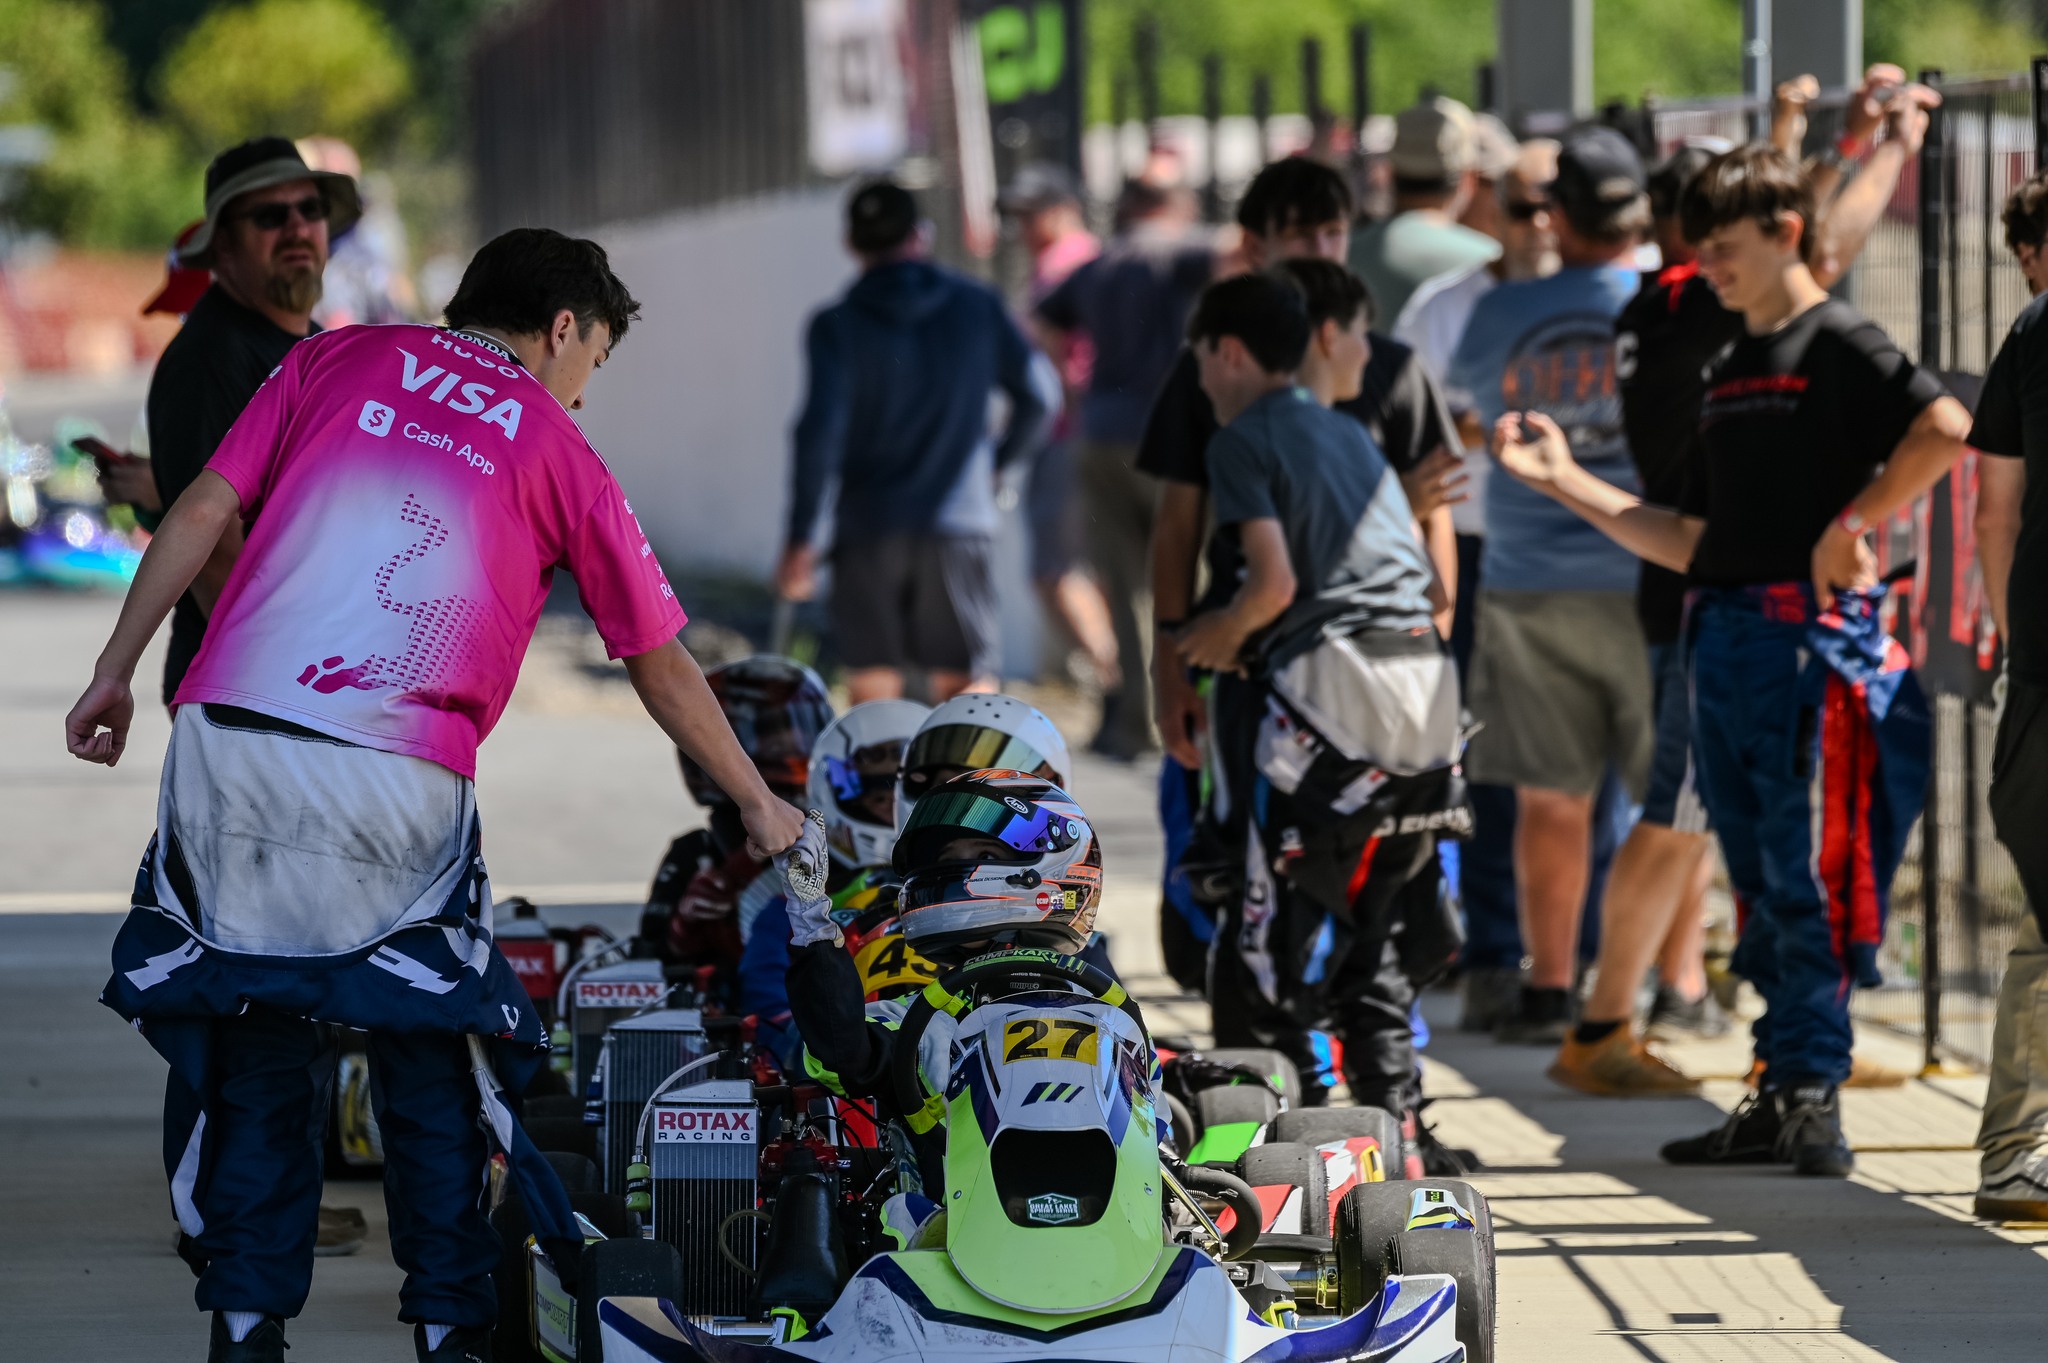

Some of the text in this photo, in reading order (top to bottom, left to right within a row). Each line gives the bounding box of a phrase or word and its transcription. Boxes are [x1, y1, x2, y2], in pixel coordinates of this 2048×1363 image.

[431, 334, 519, 379] HUGO
[444, 329, 511, 362] HONDA
[396, 346, 523, 442] VISA
[403, 422, 454, 451] Cash
[456, 444, 495, 475] App
[581, 984, 658, 997] ROTAX
[1005, 1019, 1096, 1062] 27
[658, 1111, 750, 1131] ROTAX
[658, 1132, 750, 1141] RACING
